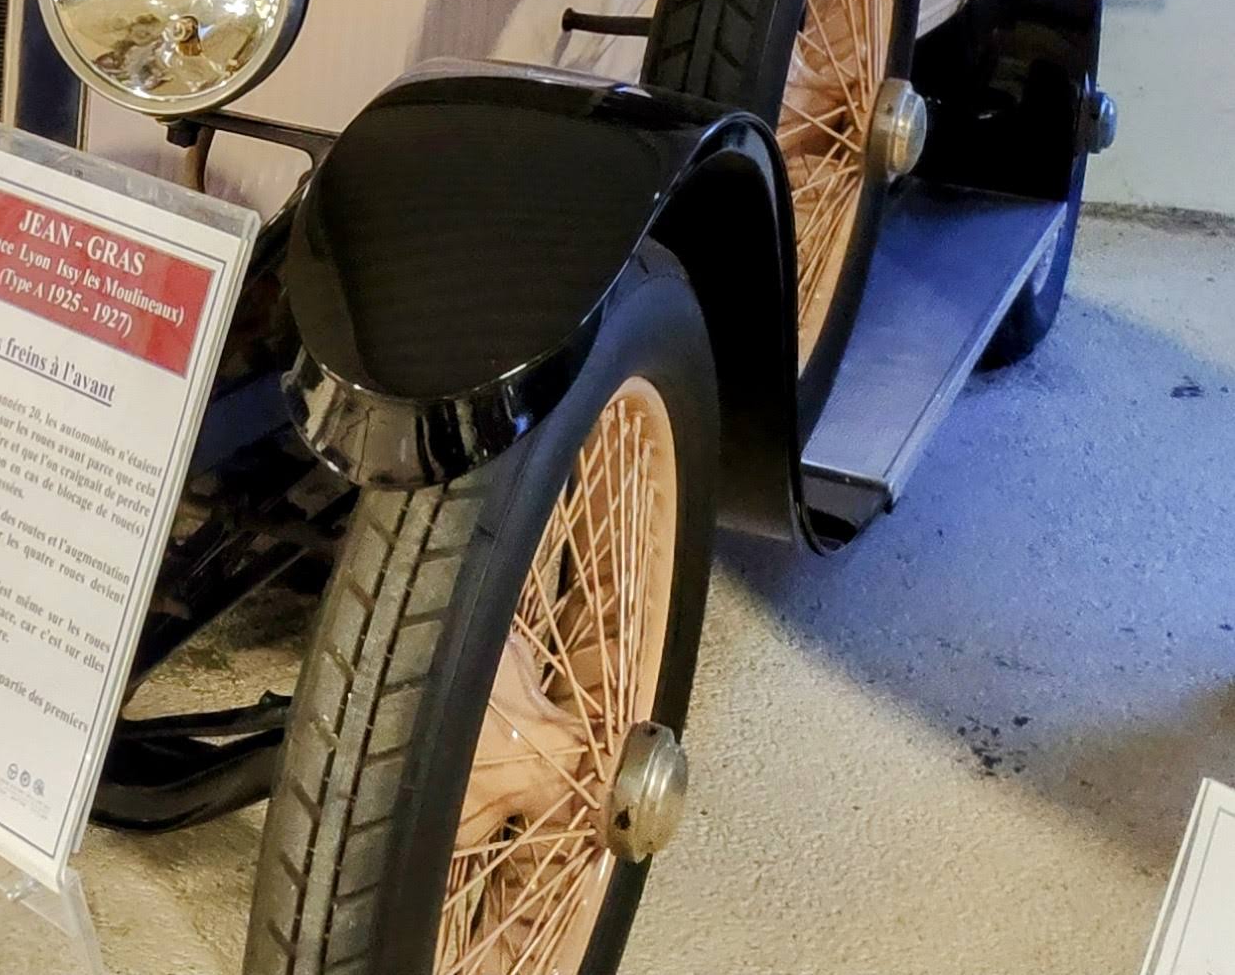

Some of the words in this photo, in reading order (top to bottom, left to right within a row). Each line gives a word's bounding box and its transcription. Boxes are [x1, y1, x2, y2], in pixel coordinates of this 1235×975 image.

[19, 210, 74, 248] JEAN
[87, 235, 145, 276] GRAS
[18, 243, 51, 270] Lyon
[56, 258, 79, 286] Issy
[82, 268, 101, 290] les
[102, 276, 185, 327] Moulineaux)
[32, 282, 43, 299] A
[47, 284, 83, 312] 1925
[92, 302, 133, 338] 1927)
[5, 337, 48, 371] freins
[49, 355, 59, 377] à
[62, 361, 115, 402] l'avant
[15, 420, 29, 437] les
[30, 430, 56, 450] roues
[57, 444, 86, 464] avant
[85, 457, 114, 478] parce
[115, 471, 134, 488] que
[135, 481, 157, 498] cela
[28, 405, 43, 424] 20,
[44, 412, 58, 429] les
[59, 423, 117, 457] automobiles
[117, 449, 163, 478] n'étaient
[9, 442, 21, 454] et
[20, 447, 39, 463] que
[39, 452, 59, 473] l'on
[59, 465, 104, 494] craignait
[103, 485, 116, 500] de
[115, 493, 151, 518] perdre
[9, 463, 22, 476] en
[23, 470, 39, 485] cas
[41, 476, 54, 492] de
[56, 482, 93, 512] blocage
[95, 503, 108, 519] de
[110, 512, 146, 539] roue(s)
[0, 509, 17, 527] des
[17, 520, 46, 542] routes
[47, 536, 58, 548] et
[57, 537, 130, 586] l'augmentation
[6, 532, 20, 550] les
[23, 544, 55, 568] quatre
[58, 563, 86, 584] roues
[89, 577, 126, 606] devient
[20, 619, 38, 635] car
[39, 628, 63, 650] c'est
[64, 643, 82, 660] sur
[82, 653, 105, 674] elles
[47, 611, 65, 627] sur
[67, 618, 81, 637] les
[83, 632, 111, 654] roues
[28, 688, 44, 707] des
[43, 701, 89, 734] premiers
